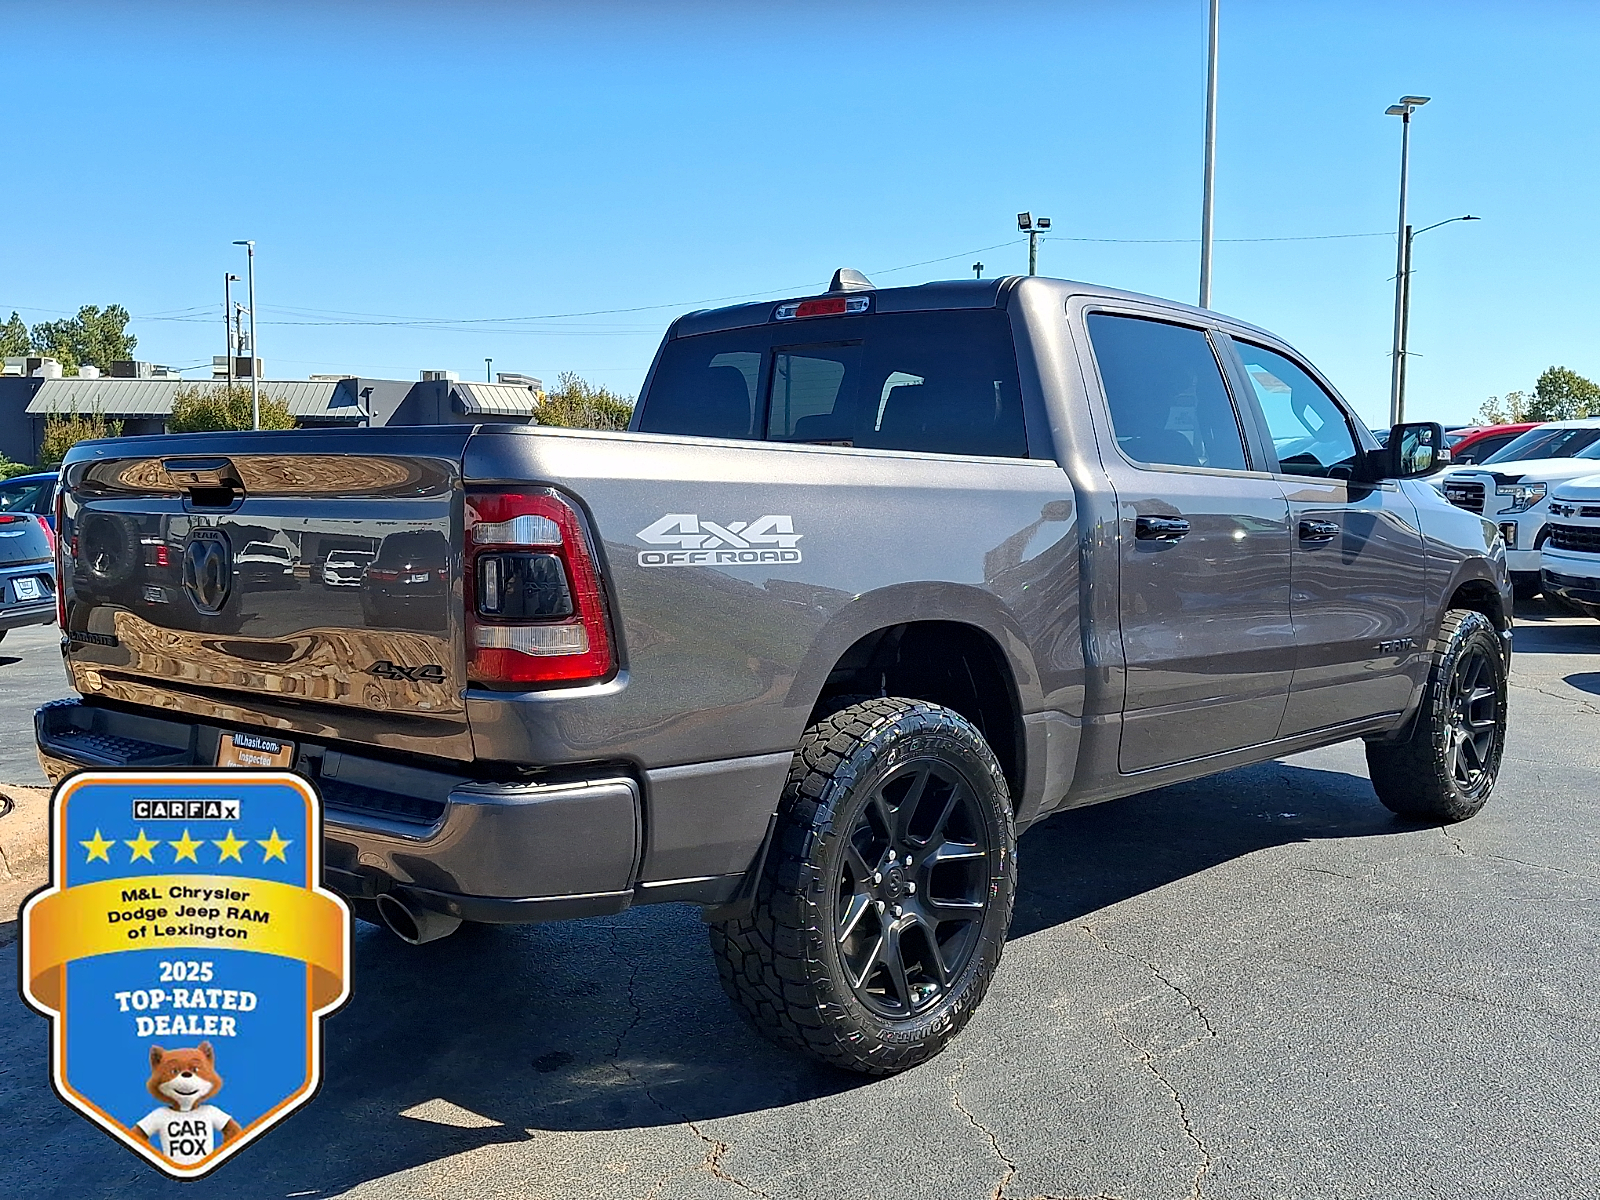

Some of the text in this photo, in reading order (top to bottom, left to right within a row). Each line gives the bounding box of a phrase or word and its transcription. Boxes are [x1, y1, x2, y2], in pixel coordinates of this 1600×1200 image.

[193, 531, 218, 540] RAM
[641, 551, 799, 565] OFF ROAD
[238, 750, 272, 766] Inspected
